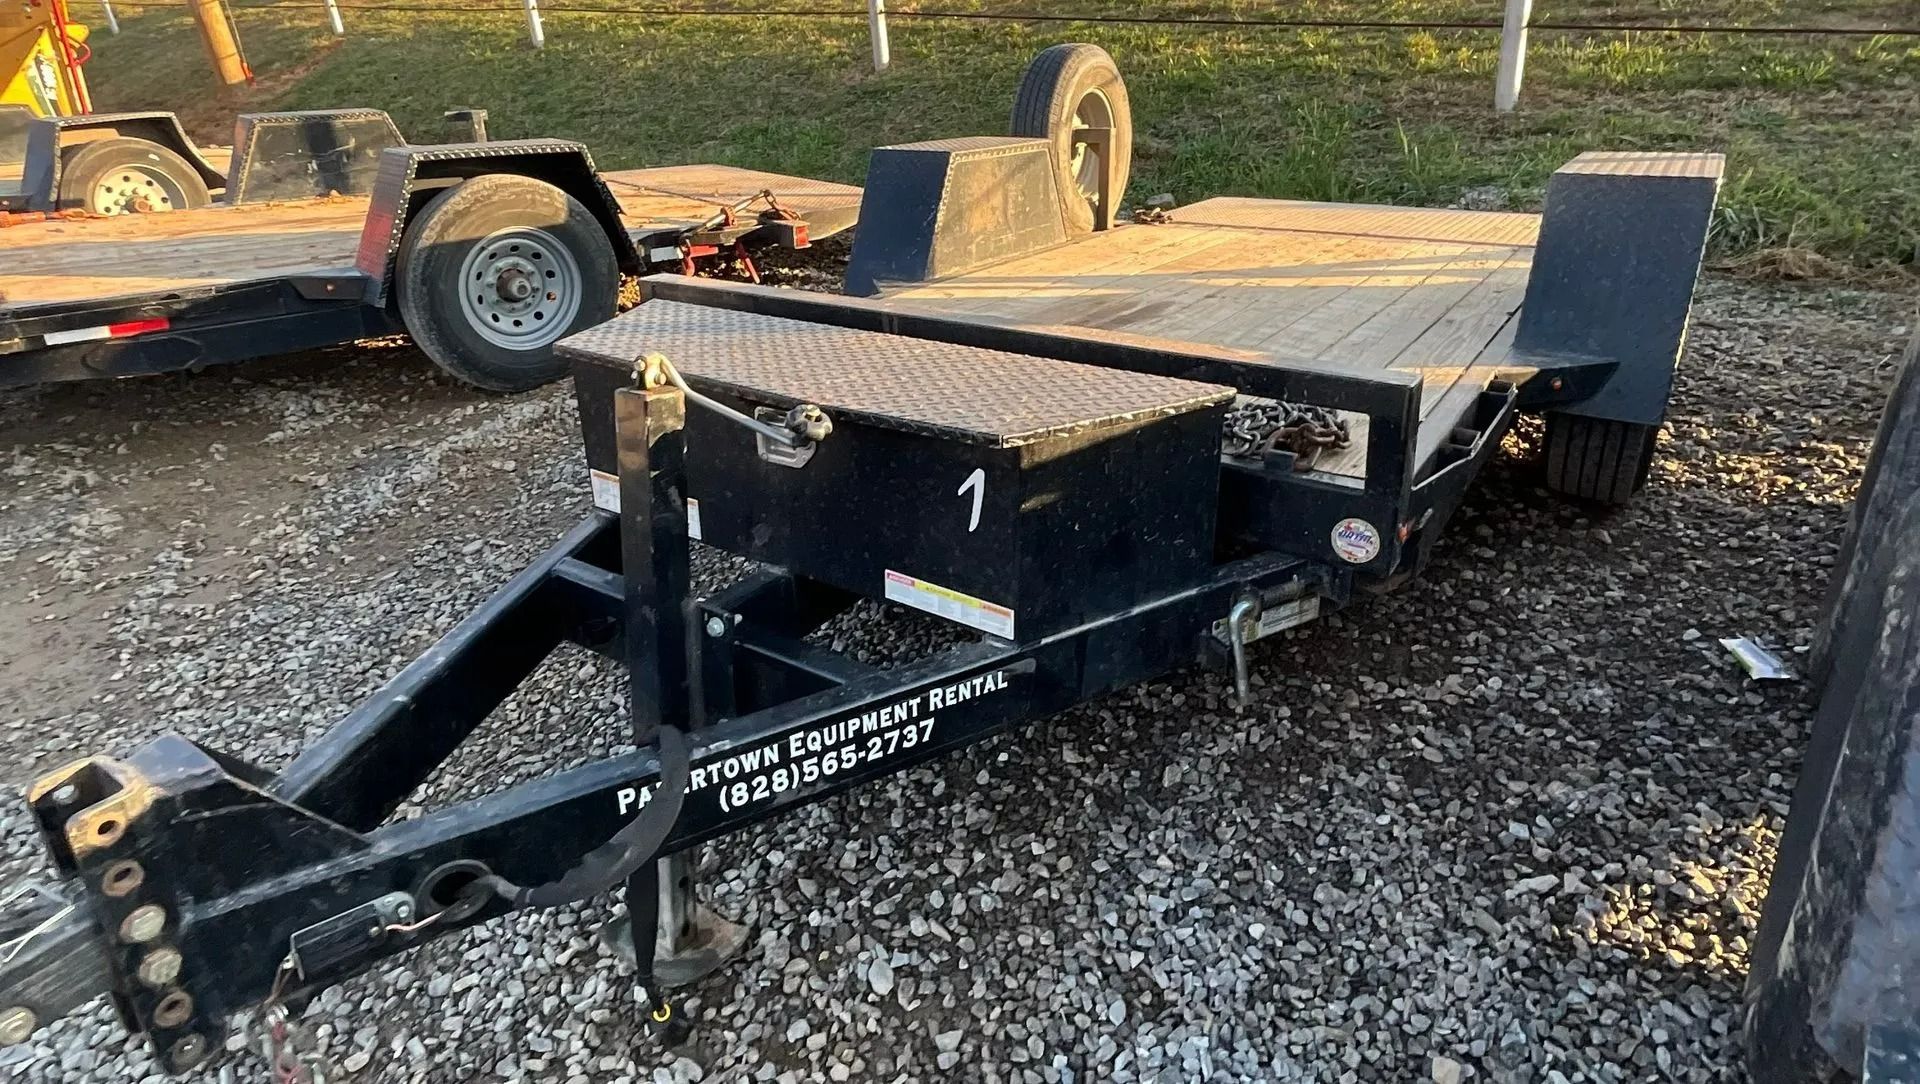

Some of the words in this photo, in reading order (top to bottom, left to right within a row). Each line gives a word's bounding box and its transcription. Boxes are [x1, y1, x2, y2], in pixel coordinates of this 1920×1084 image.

[957, 467, 985, 532] 1
[616, 742, 780, 816] PARTOWN
[787, 696, 922, 757] EQUIPMENT
[929, 671, 1009, 712] RENTAL
[719, 716, 936, 813] (828)565-2737
